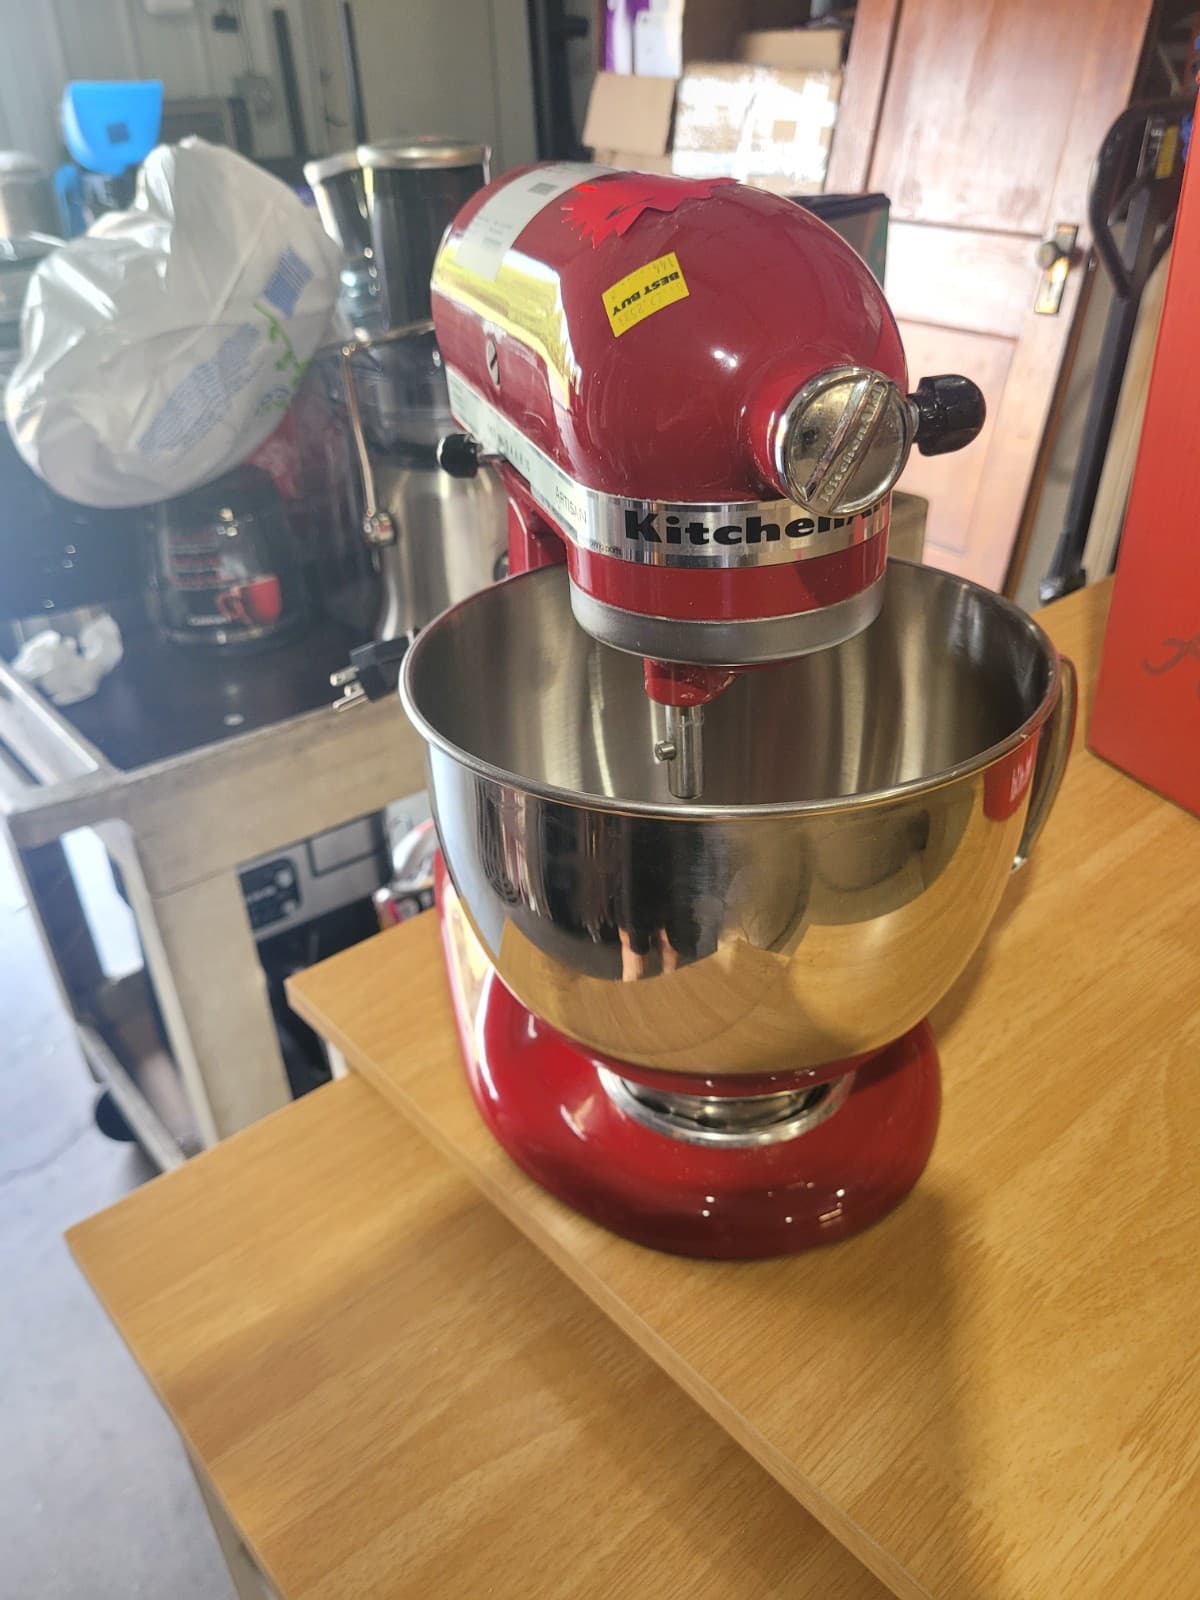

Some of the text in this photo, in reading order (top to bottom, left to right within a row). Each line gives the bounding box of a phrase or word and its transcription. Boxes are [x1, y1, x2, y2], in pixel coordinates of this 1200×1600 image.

[643, 271, 680, 296] BEST
[612, 290, 641, 317] BUY
[625, 503, 885, 545] Kitchen
